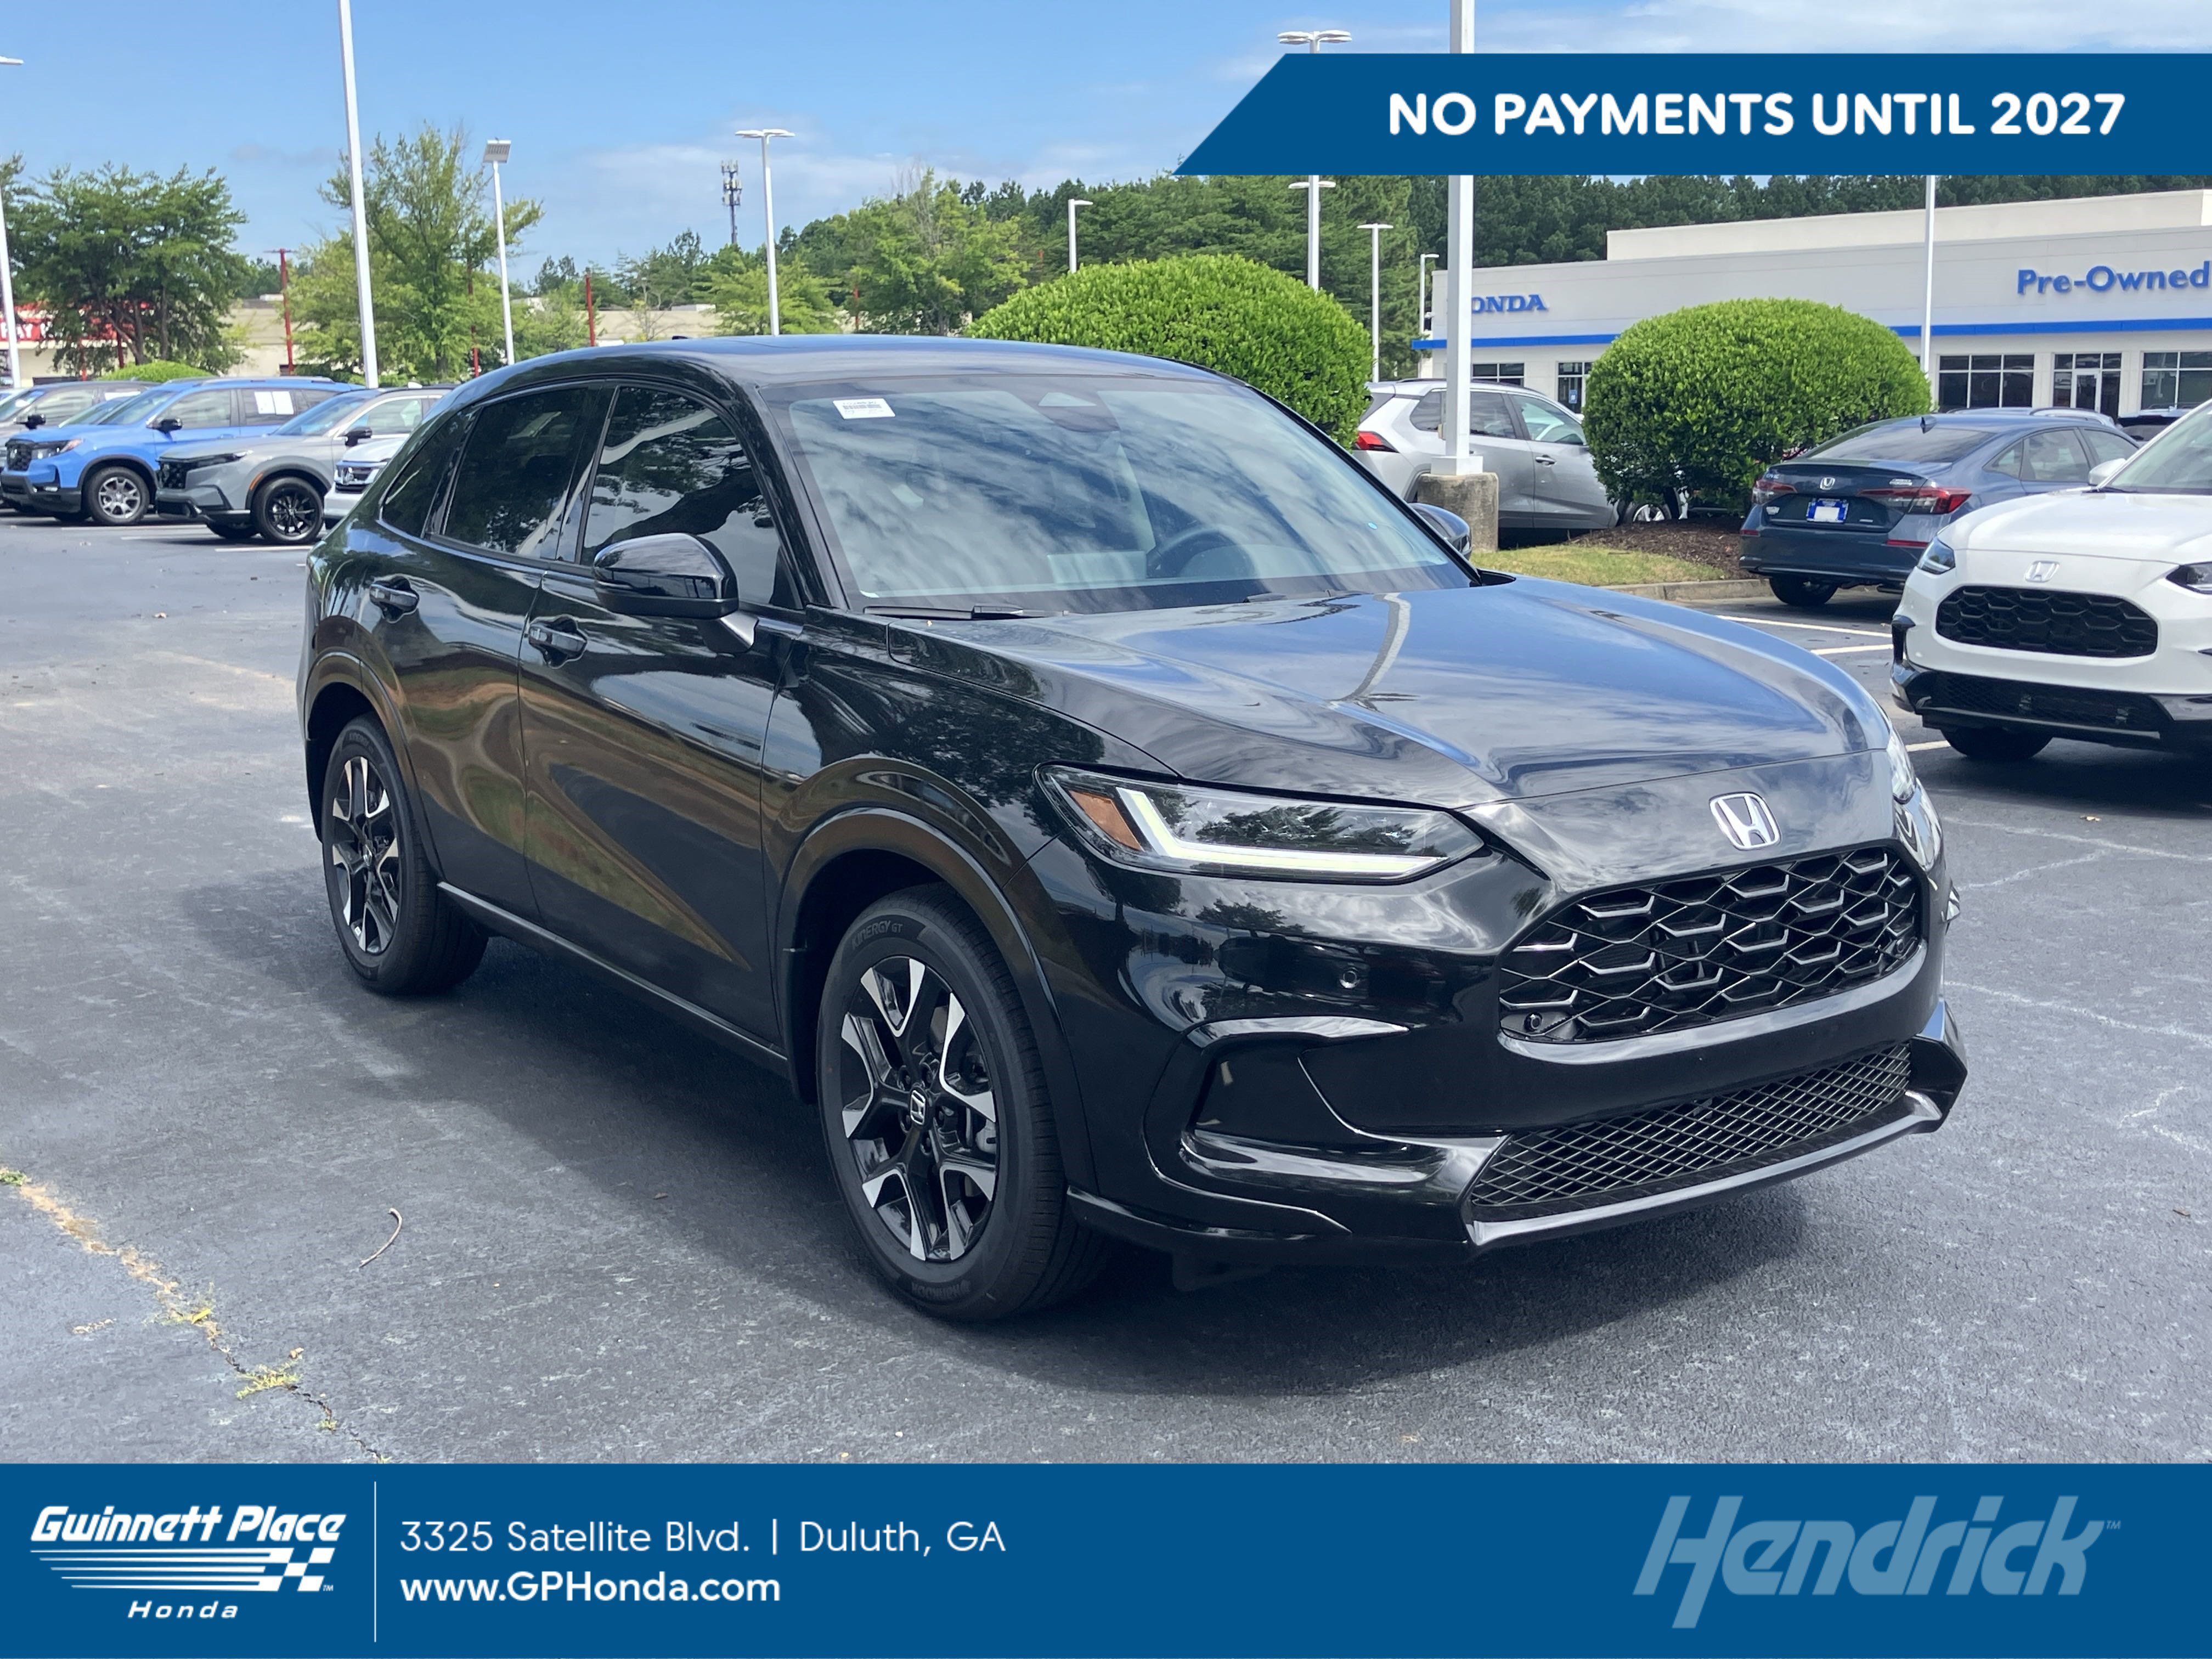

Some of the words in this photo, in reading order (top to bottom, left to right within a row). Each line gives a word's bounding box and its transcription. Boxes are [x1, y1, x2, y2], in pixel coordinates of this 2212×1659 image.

[2017, 261, 2210, 295] Pre-Owned
[1447, 294, 1548, 314] ONDA
[891, 923, 904, 933] GT
